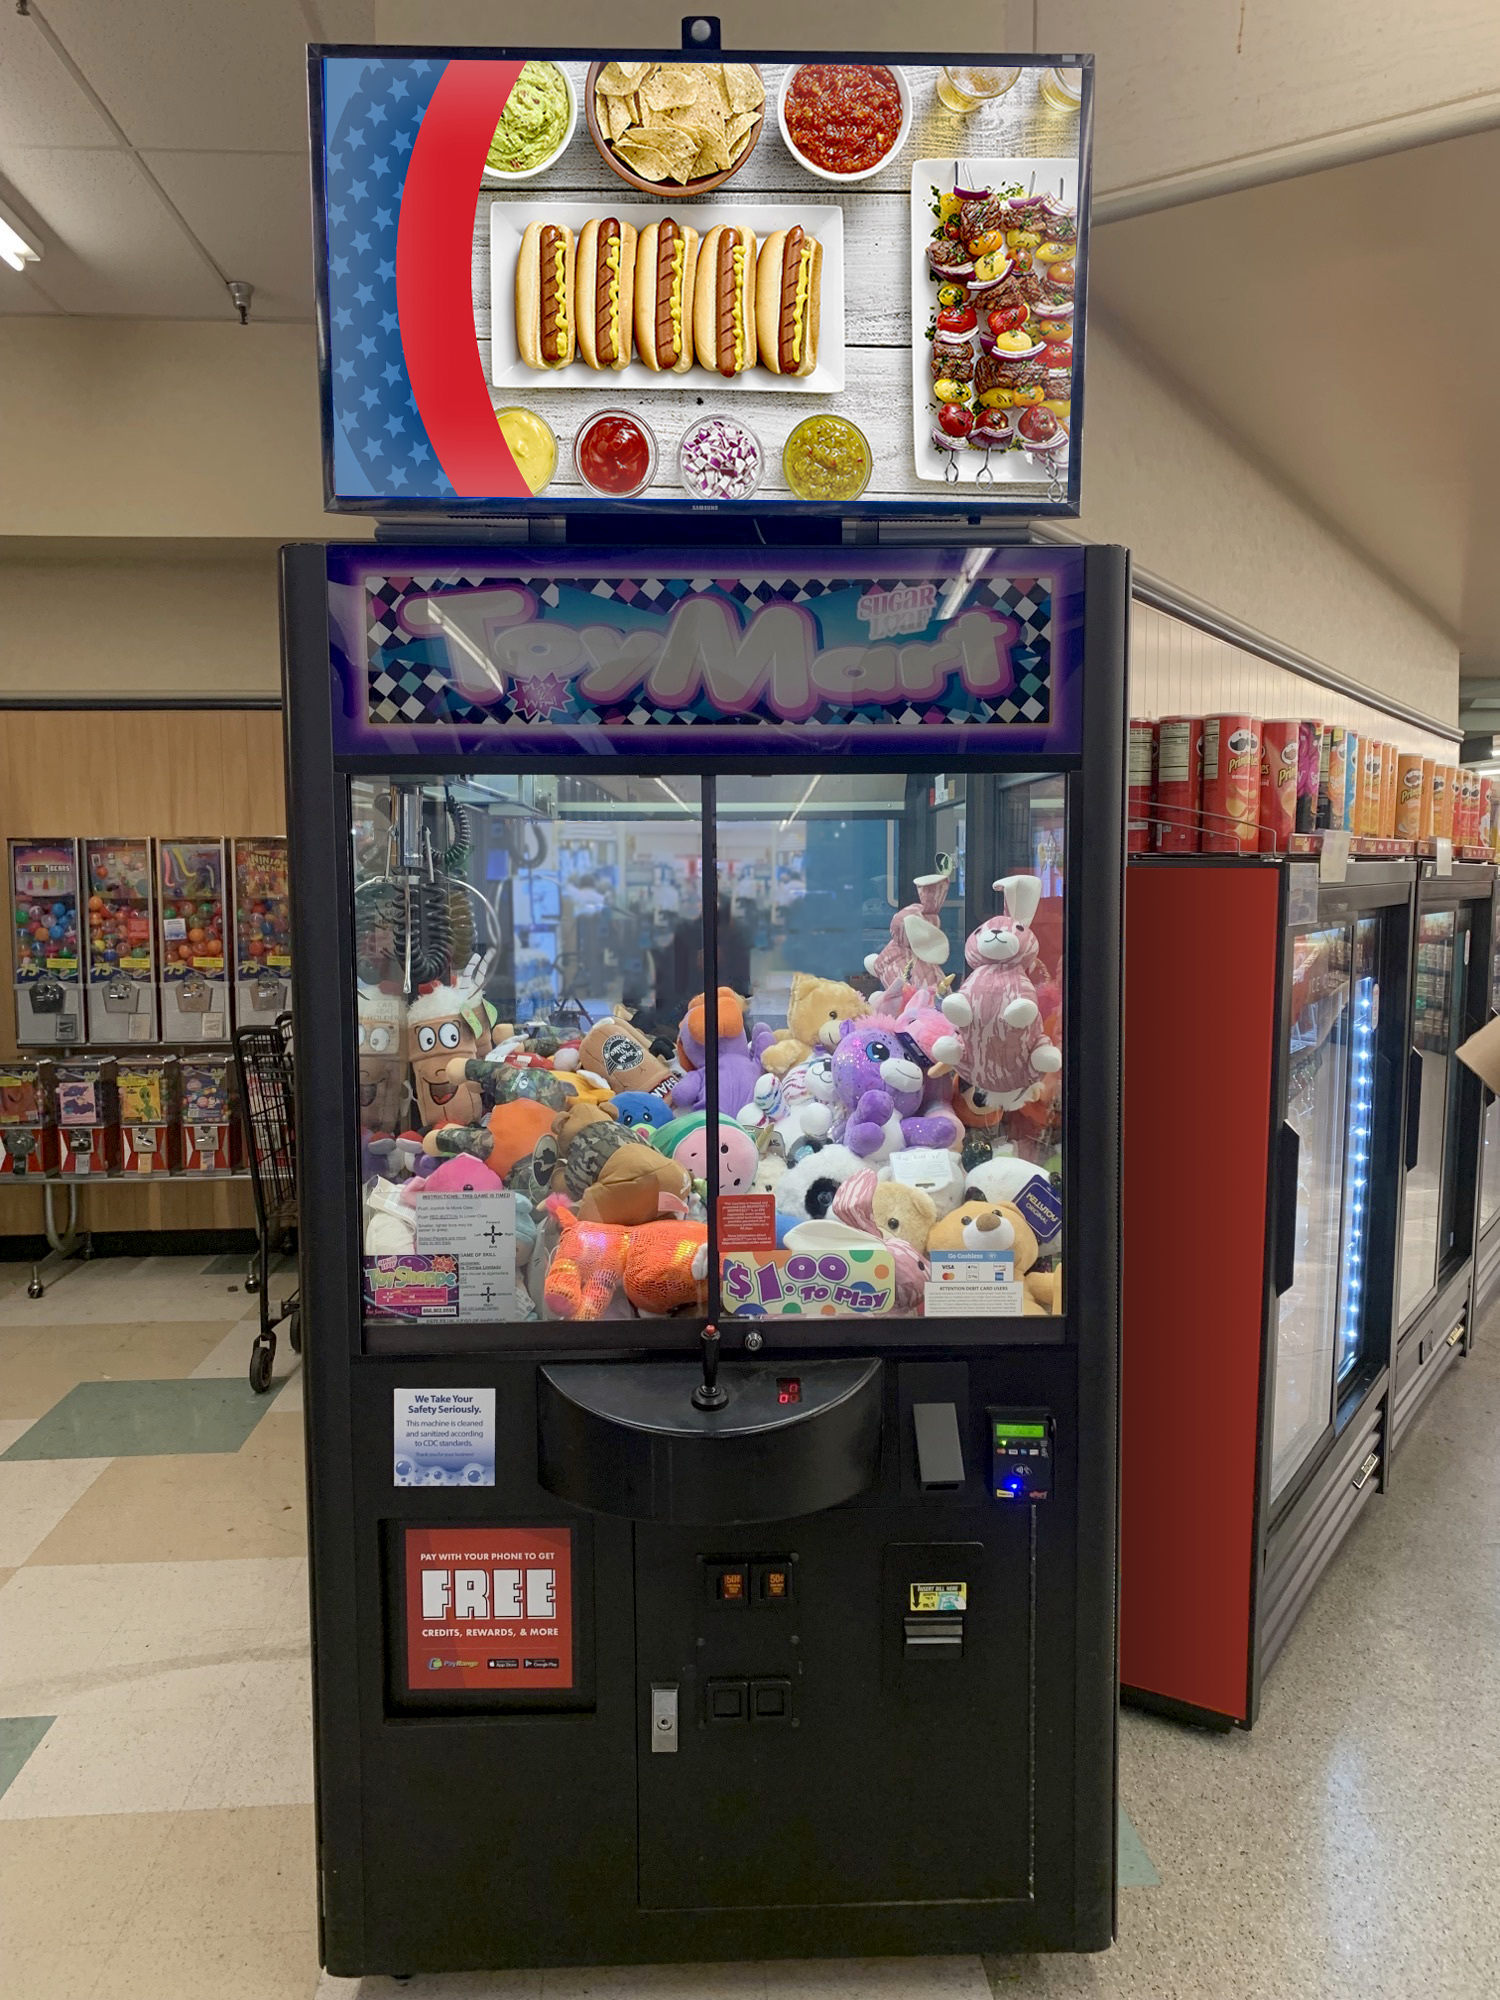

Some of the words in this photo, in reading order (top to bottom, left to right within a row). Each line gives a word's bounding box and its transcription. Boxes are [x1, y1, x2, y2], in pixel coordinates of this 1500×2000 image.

[1026, 1192, 1058, 1222] KELLYTOY
[957, 1252, 983, 1260] Cashless
[832, 1284, 891, 1312] Play
[415, 1395, 429, 1403] We
[430, 1395, 451, 1403] Take
[452, 1395, 473, 1403] Your
[408, 1405, 436, 1415] Safety
[438, 1405, 481, 1415] Seriously.
[538, 1552, 555, 1560] GET
[770, 1574, 784, 1583] 50¢
[420, 1568, 556, 1620] FREE
[422, 1629, 463, 1637] CREDITS,
[466, 1629, 516, 1637] REWARDS,
[530, 1628, 558, 1636] MORE
